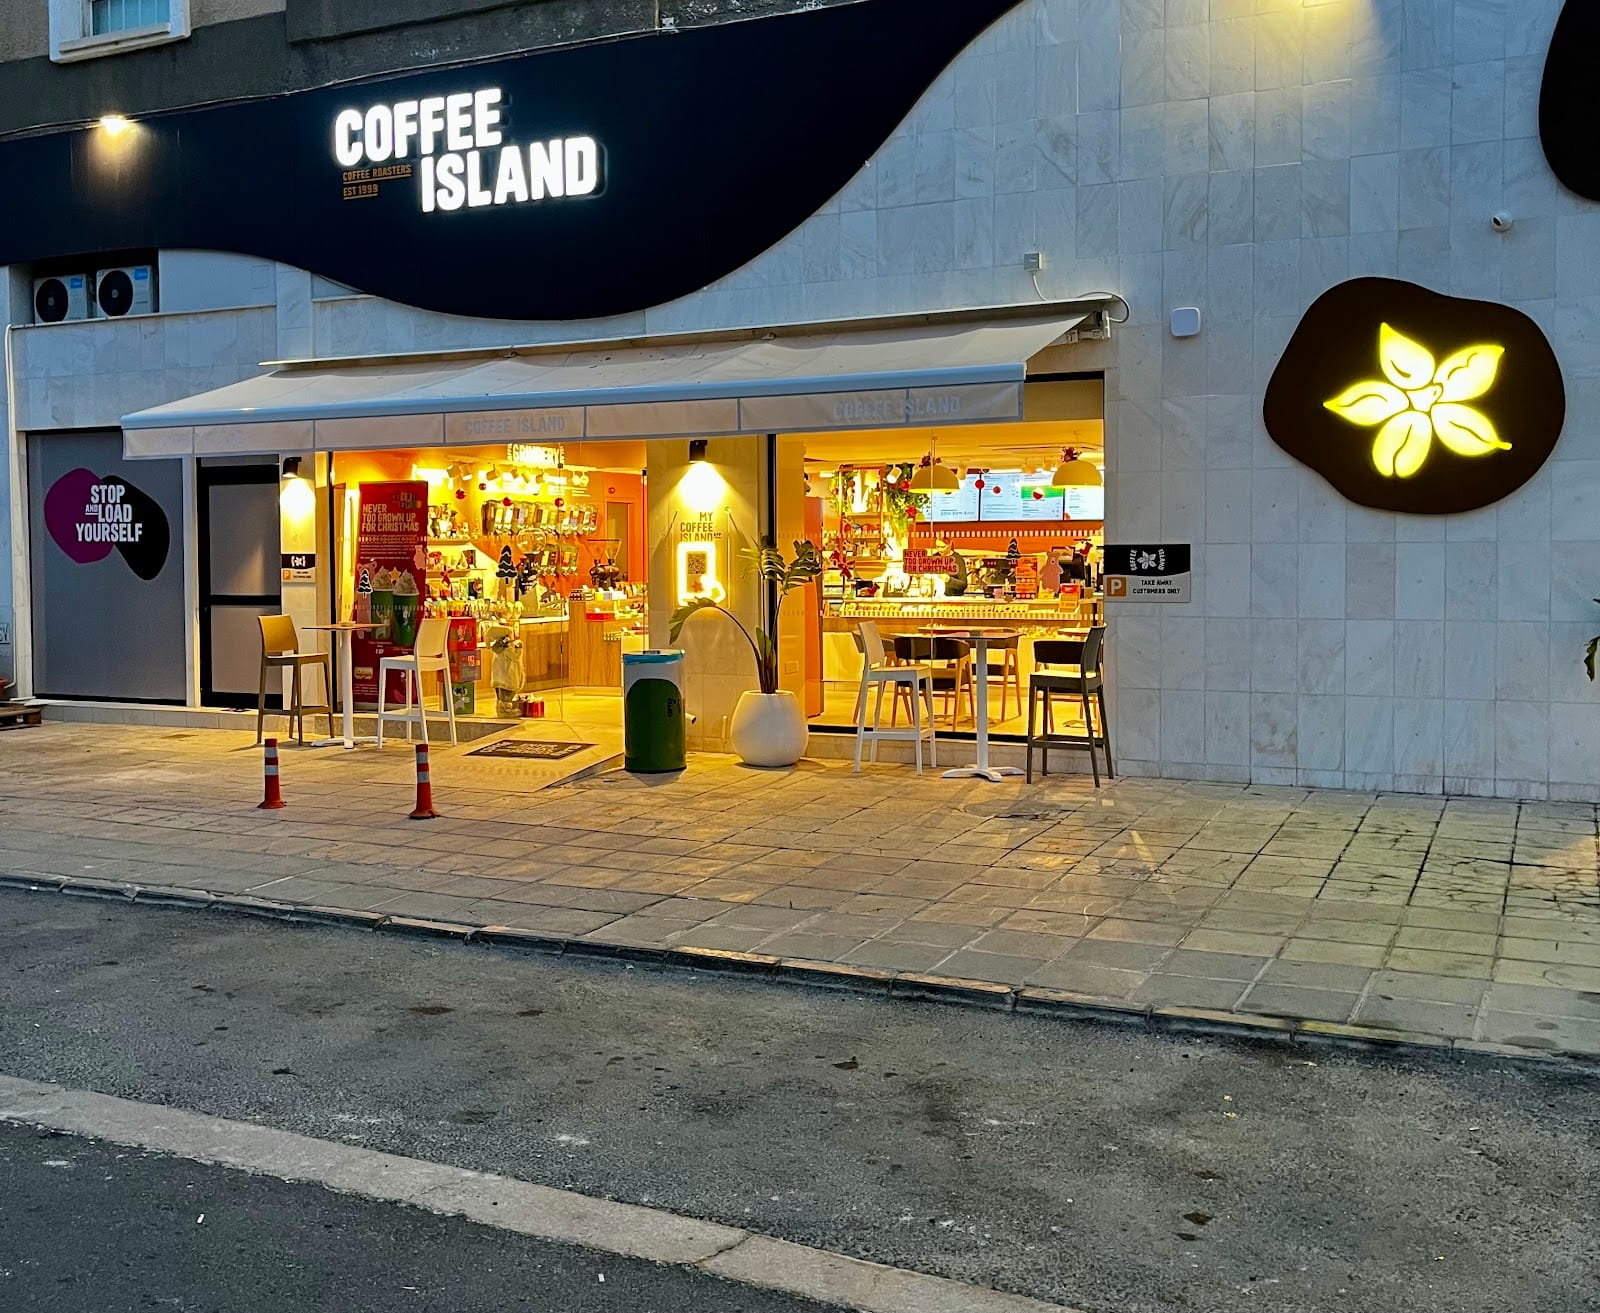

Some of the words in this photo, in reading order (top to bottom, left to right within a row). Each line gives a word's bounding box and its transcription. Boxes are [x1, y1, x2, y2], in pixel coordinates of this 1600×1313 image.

[335, 88, 502, 166] COFFEE
[343, 169, 371, 181] COFFEE
[372, 164, 412, 178] ROASTERS
[421, 136, 598, 213] ISLAND
[343, 187, 357, 197] EST
[358, 184, 379, 195] 1999
[464, 418, 511, 436] COFFEE
[515, 415, 566, 433] ISLAND
[90, 484, 126, 504] STOP
[85, 503, 99, 513] AND
[98, 503, 132, 523] LOAD
[362, 504, 388, 513] NEVER
[362, 513, 377, 523] TOO
[377, 513, 405, 523] GROWN
[406, 513, 417, 523] UP
[699, 511, 714, 521] MY
[75, 522, 143, 542] YOURSELF
[361, 522, 377, 532] FOR
[377, 522, 420, 532] CHRISTMAS
[680, 522, 714, 533] COFFEE
[680, 532, 714, 542] ISLAND
[905, 557, 917, 565] TOO
[918, 557, 943, 565] GROWN
[944, 557, 954, 565] UP
[918, 565, 957, 573] CHRISTMAS
[1110, 578, 1122, 595] P
